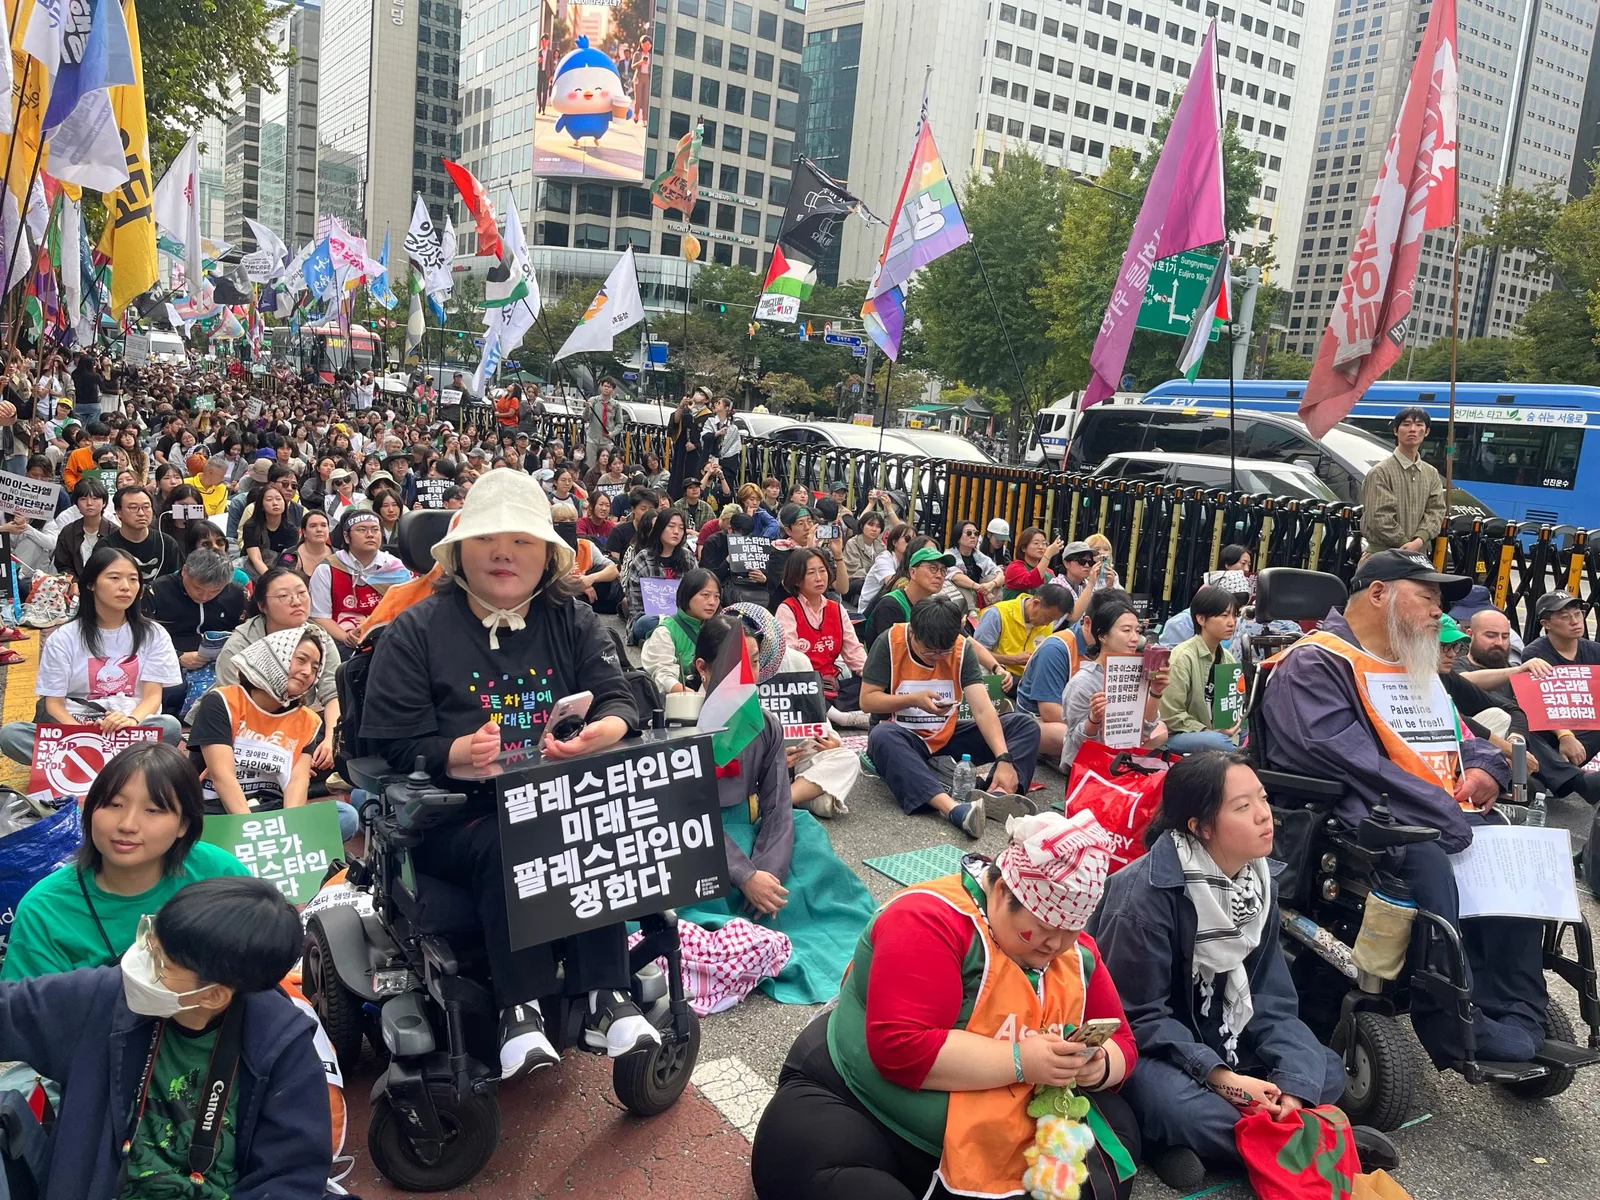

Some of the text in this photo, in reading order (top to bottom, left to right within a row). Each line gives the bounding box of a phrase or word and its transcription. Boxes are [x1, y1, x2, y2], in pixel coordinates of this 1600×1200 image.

[1180, 256, 1215, 271] Sungnyemun
[1178, 268, 1195, 280] Euljiro
[1453, 409, 1584, 424] 전기버스 타고 숨 쉬는 서울로
[1542, 478, 1570, 489] 선진운수
[15, 506, 45, 515] Genocide
[742, 544, 764, 554] 미래는
[744, 560, 767, 570] 정한다
[1107, 673, 1142, 683] 가자 집단학살
[757, 681, 819, 697] OLLARS
[1382, 683, 1409, 691] From the
[1540, 680, 1590, 694] 이스라엘
[479, 689, 554, 710] 모든 차별에
[759, 697, 791, 711] EED
[1117, 694, 1138, 703] 중단하라
[1542, 693, 1594, 706] 국채 투자
[1390, 704, 1432, 715] Palestine
[1545, 707, 1597, 720] 철회하라!
[1405, 719, 1417, 729] be
[39, 727, 63, 739] NO
[101, 730, 159, 742] 이스라엘
[38, 740, 78, 752] STOP
[245, 749, 269, 760] 장애인
[271, 754, 286, 765] 권리
[35, 761, 67, 770] STOP
[503, 744, 703, 825] 팔레스타인의
[560, 795, 659, 844] 미래는
[242, 815, 287, 841] 우리
[234, 833, 304, 863] 모두가
[512, 813, 714, 900] 팔레스타인이
[569, 860, 672, 919] 정한다
[201, 1079, 225, 1132] Canon
